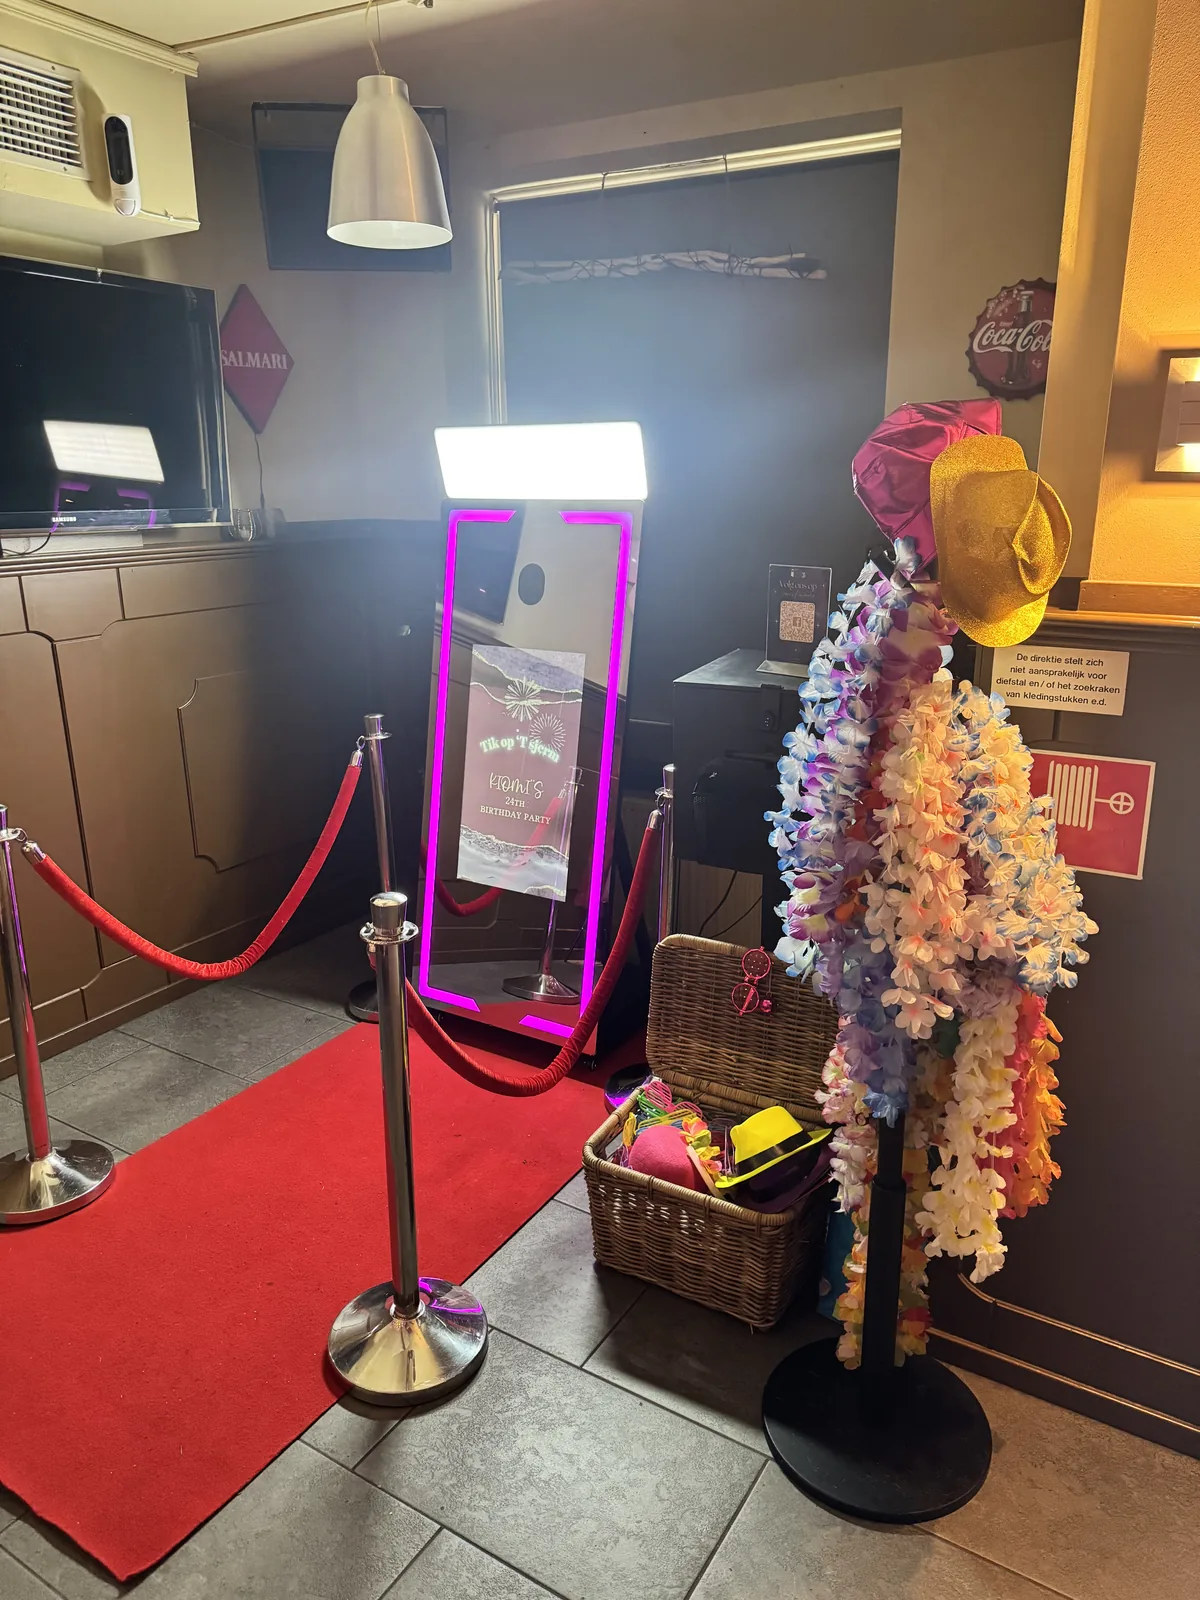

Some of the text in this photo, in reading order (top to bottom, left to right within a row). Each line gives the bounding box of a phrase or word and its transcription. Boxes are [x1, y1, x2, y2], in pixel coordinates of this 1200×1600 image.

[973, 320, 1053, 353] Coca-Col
[221, 349, 288, 370] SALMARI
[1016, 653, 1104, 667] De direktie stelt zich
[1010, 666, 1108, 680] niet aansprakelijk voor
[996, 677, 1027, 686] diefstal
[1057, 682, 1071, 690] het
[1073, 684, 1120, 694] zoekraken
[1023, 692, 1089, 703] kledingstukken
[1091, 698, 1107, 706] e.d.
[480, 736, 500, 753] Tik
[500, 738, 515, 751] op
[505, 796, 525, 808] 24TH
[480, 805, 551, 825] BIRTHDAY PARTY
